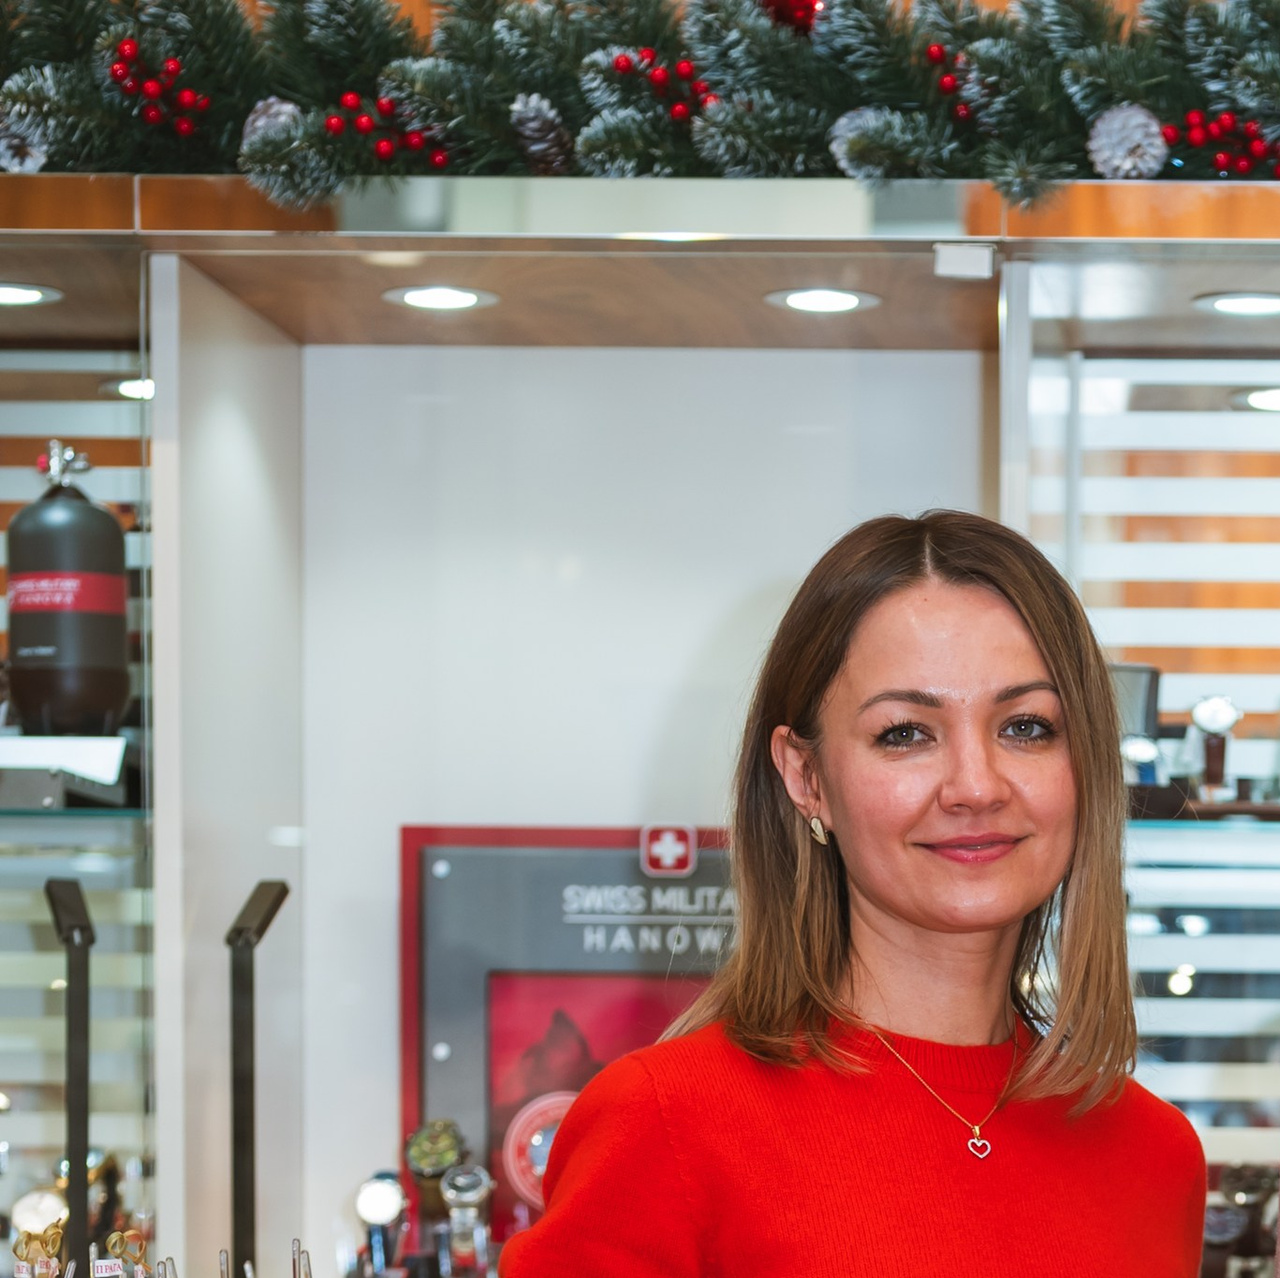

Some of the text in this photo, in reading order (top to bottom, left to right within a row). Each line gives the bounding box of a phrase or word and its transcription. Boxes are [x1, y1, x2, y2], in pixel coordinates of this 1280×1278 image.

[562, 884, 738, 914] SWISS MILITA
[583, 925, 730, 954] HANOW
